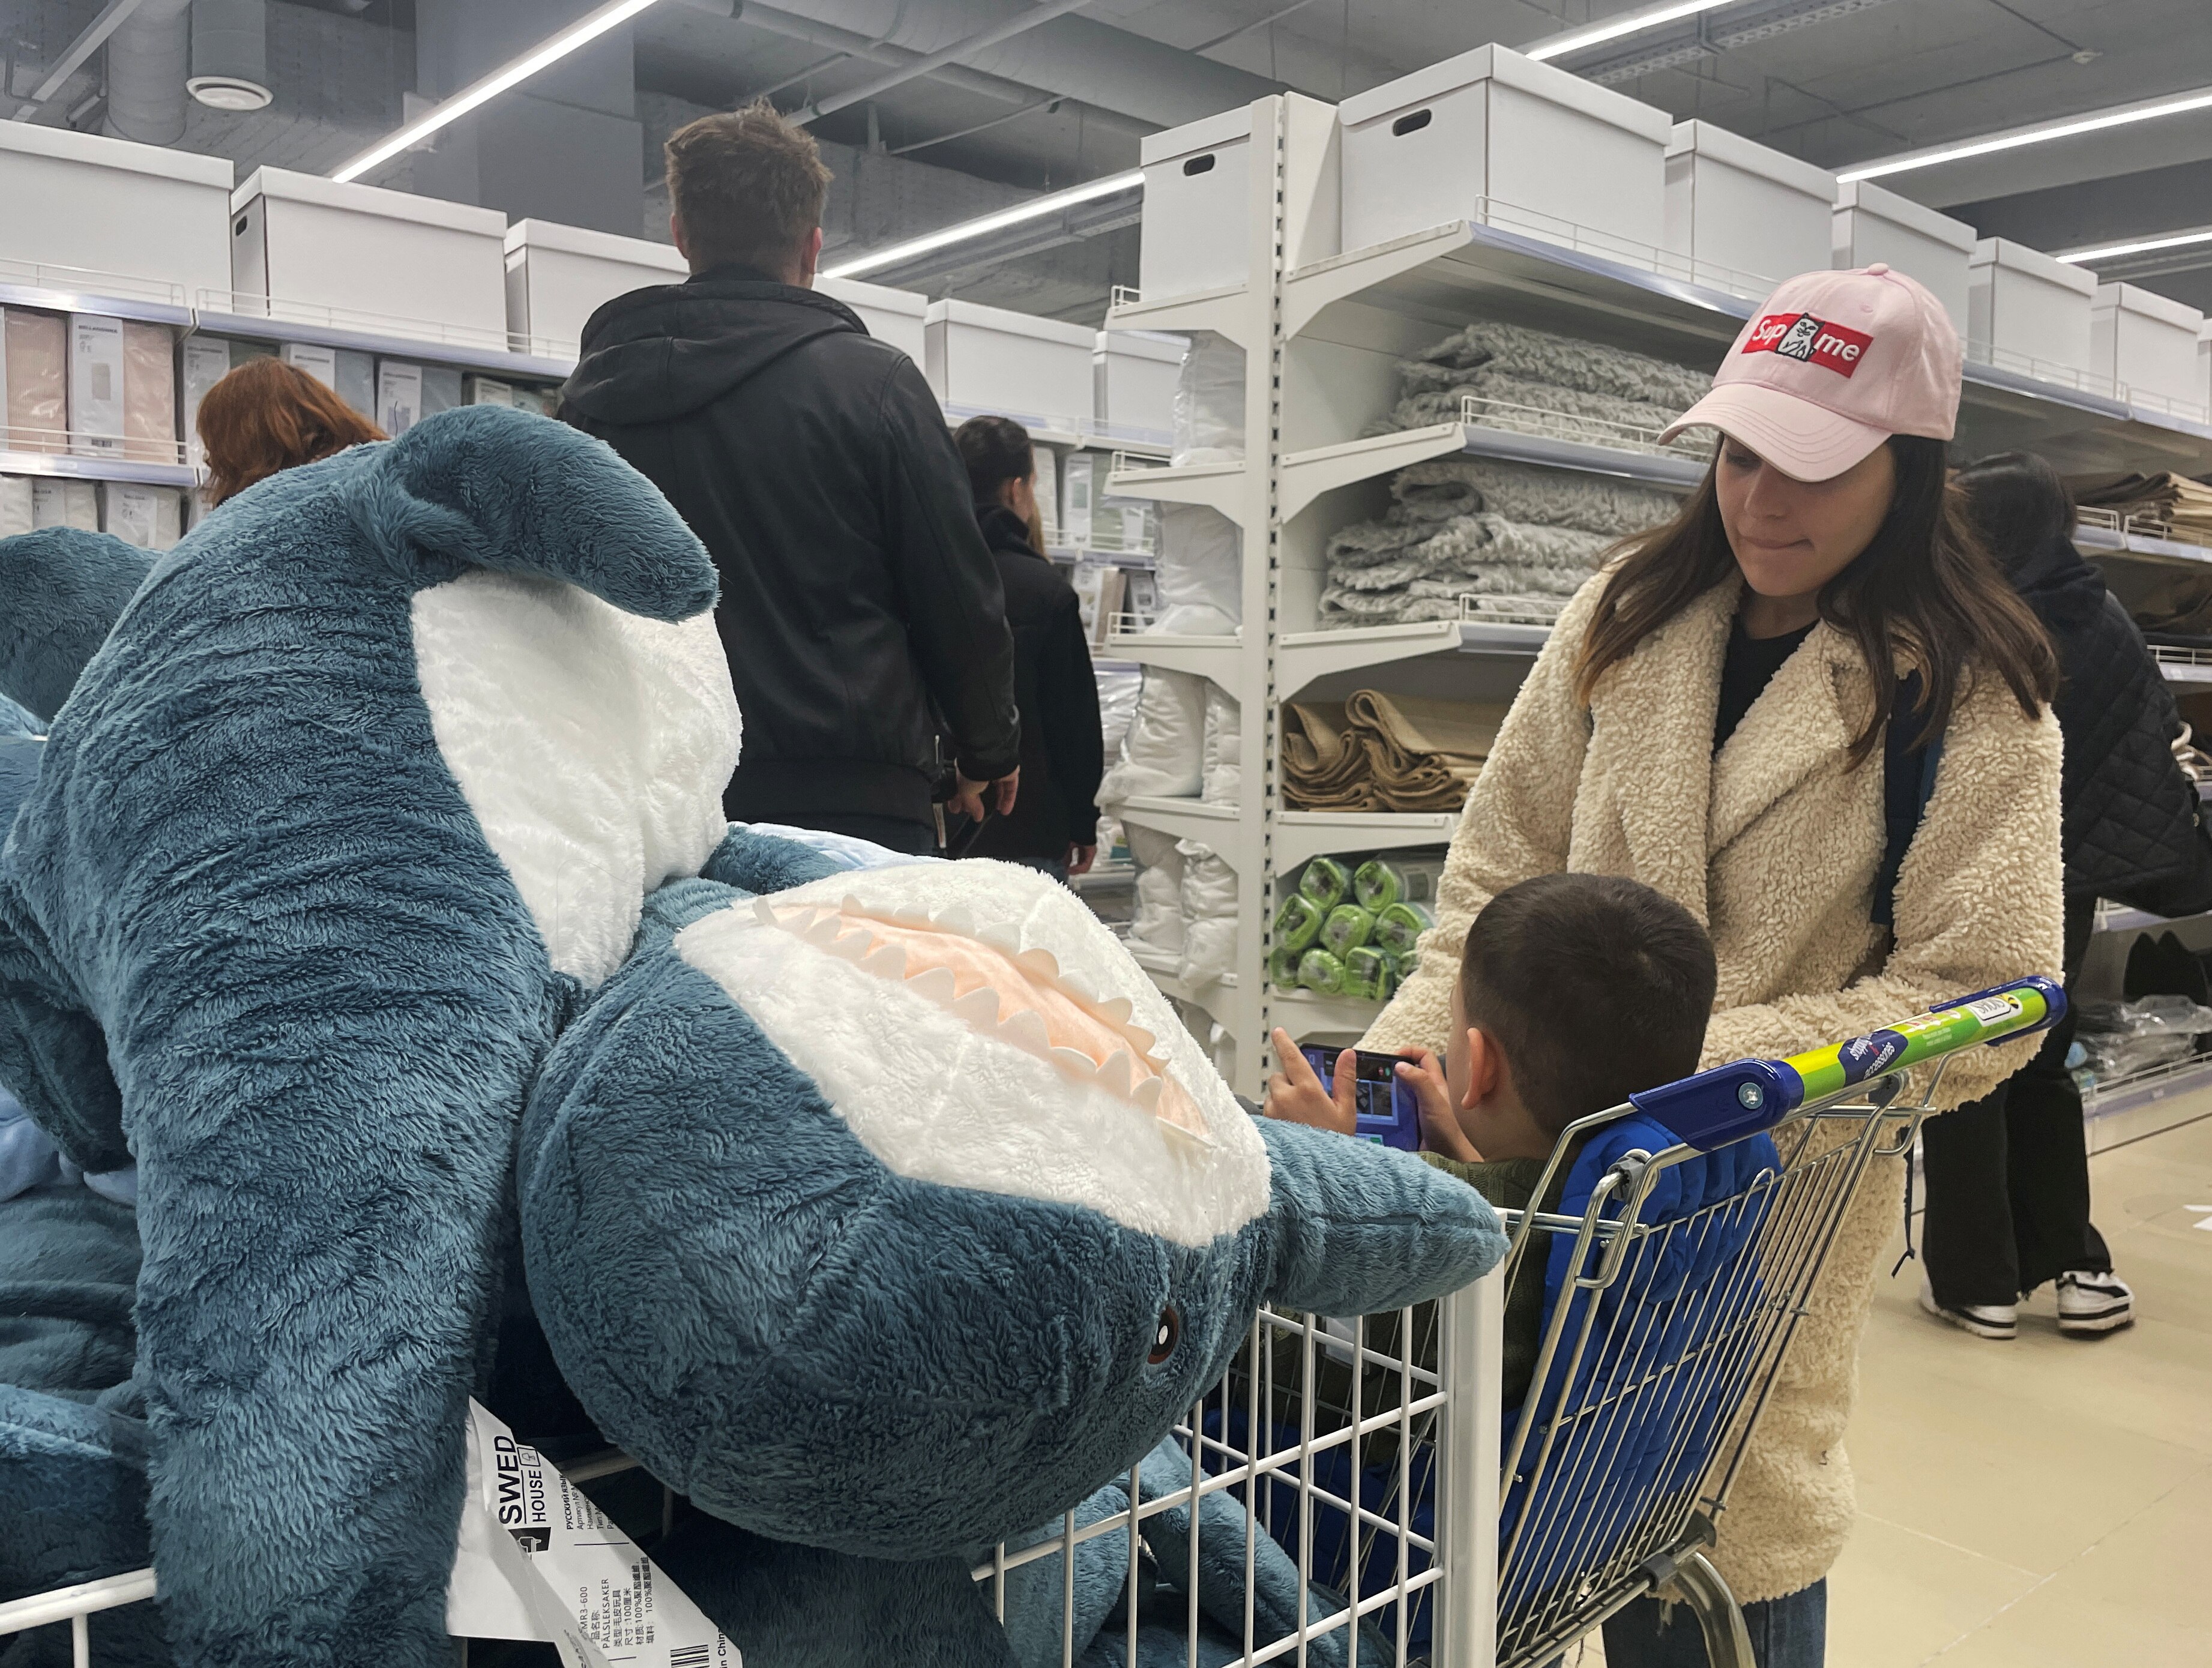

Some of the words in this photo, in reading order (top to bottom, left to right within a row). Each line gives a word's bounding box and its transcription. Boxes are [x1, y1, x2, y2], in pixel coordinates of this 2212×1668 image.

[1752, 319, 1787, 345] Sup
[1813, 333, 1860, 361] me
[493, 1435, 522, 1525] SWED
[528, 1470, 546, 1522] HOUSE
[561, 1494, 573, 1530] РУССКИЙ
[575, 1501, 585, 1530] Артикул
